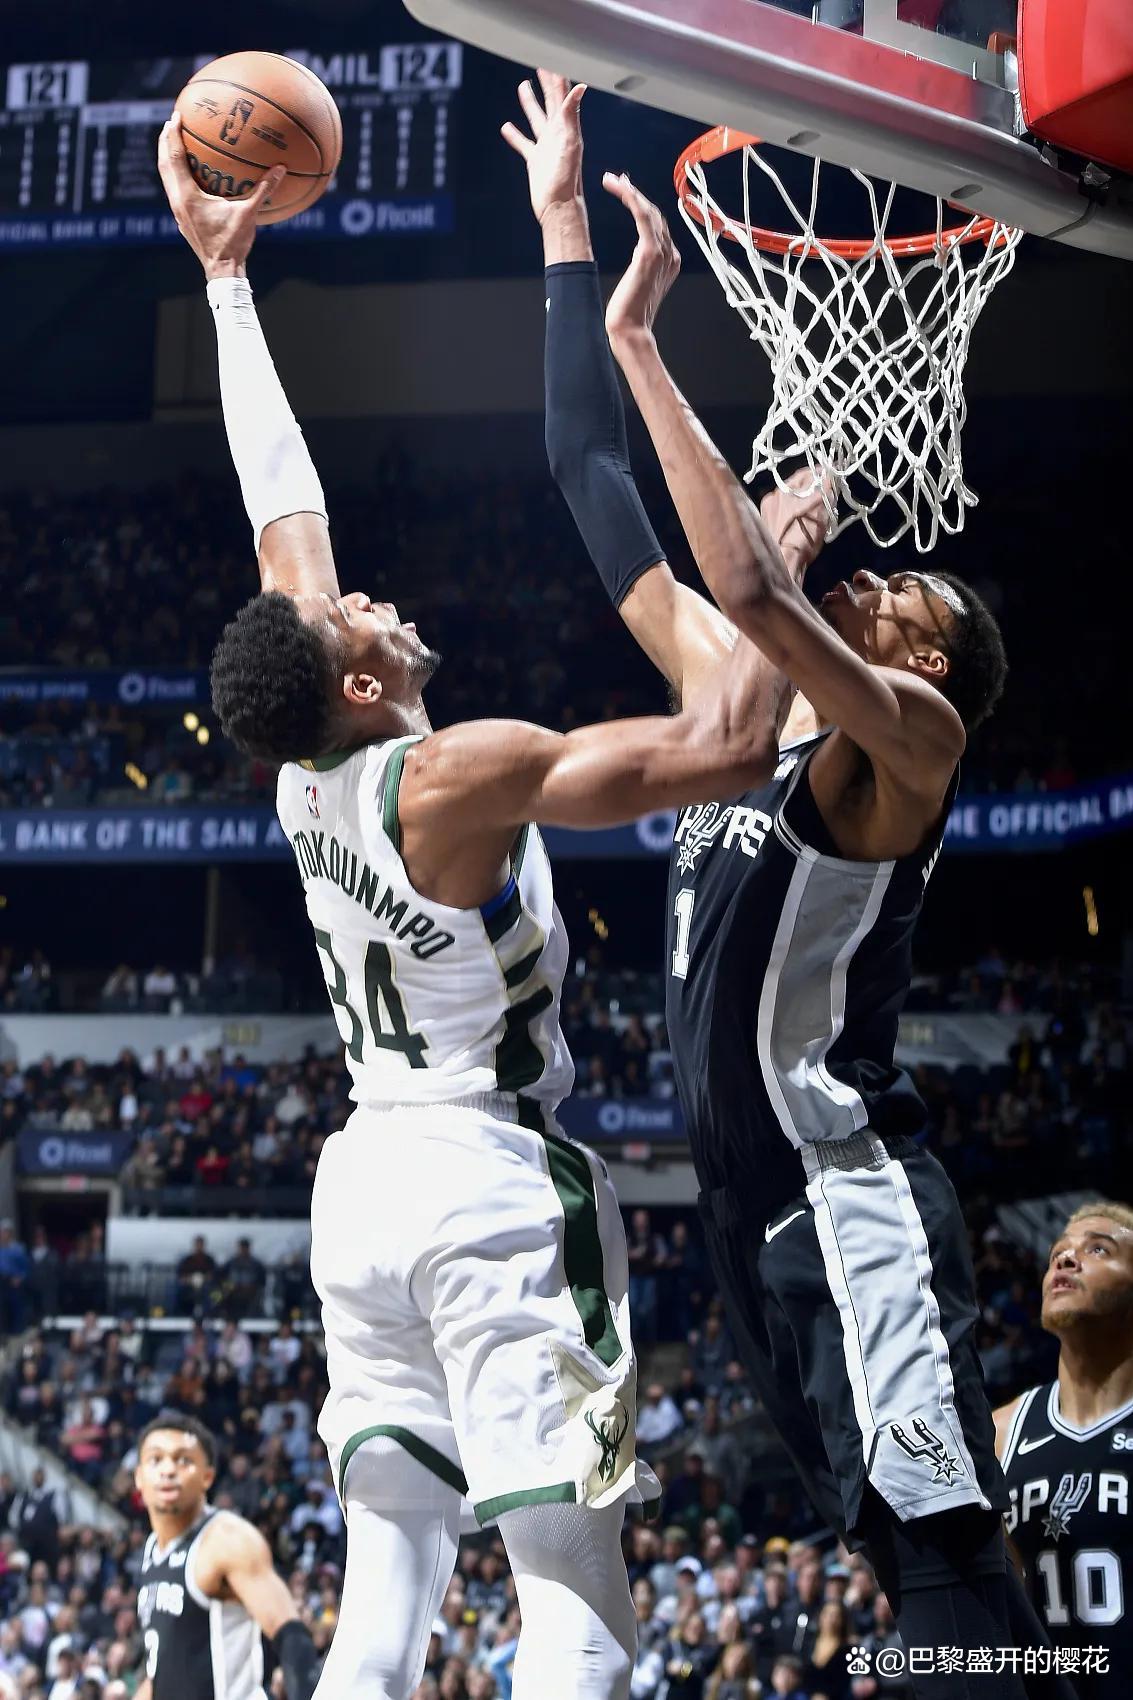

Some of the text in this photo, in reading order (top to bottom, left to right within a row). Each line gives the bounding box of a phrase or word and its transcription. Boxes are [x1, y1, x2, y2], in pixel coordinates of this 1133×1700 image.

[24, 67, 69, 104] 121
[314, 53, 379, 87] MIL
[392, 47, 450, 88] 124
[15, 820, 89, 851] BANK
[96, 820, 131, 850] OF
[140, 819, 191, 850] THE
[201, 819, 257, 849] SAN
[989, 796, 1105, 838] OFFICIAL
[671, 887, 696, 981] 1
[315, 929, 430, 1069] 34
[1035, 1548, 1126, 1627] 10
